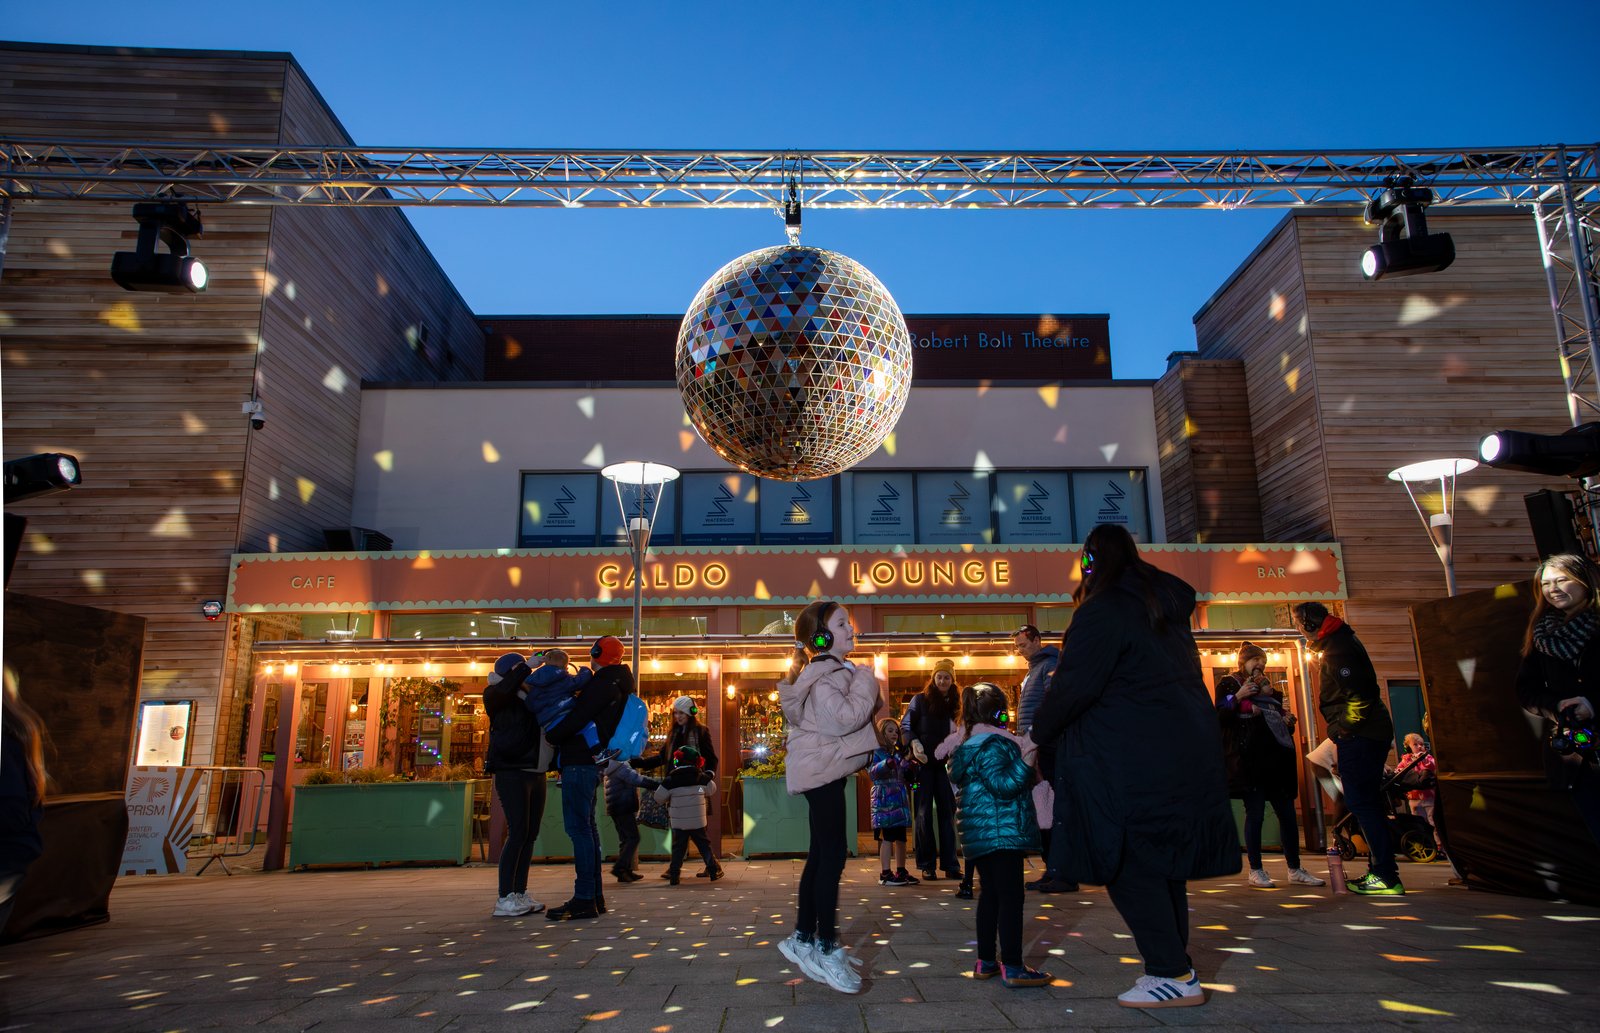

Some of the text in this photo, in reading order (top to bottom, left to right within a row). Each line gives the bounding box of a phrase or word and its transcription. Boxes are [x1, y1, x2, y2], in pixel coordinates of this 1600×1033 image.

[909, 331, 1090, 348] Robert Bolt Theatre
[598, 561, 1009, 588] CALDO LOUNGE
[1257, 567, 1286, 578] BAR
[291, 576, 335, 589] CAFE
[127, 804, 166, 816] PRISM
